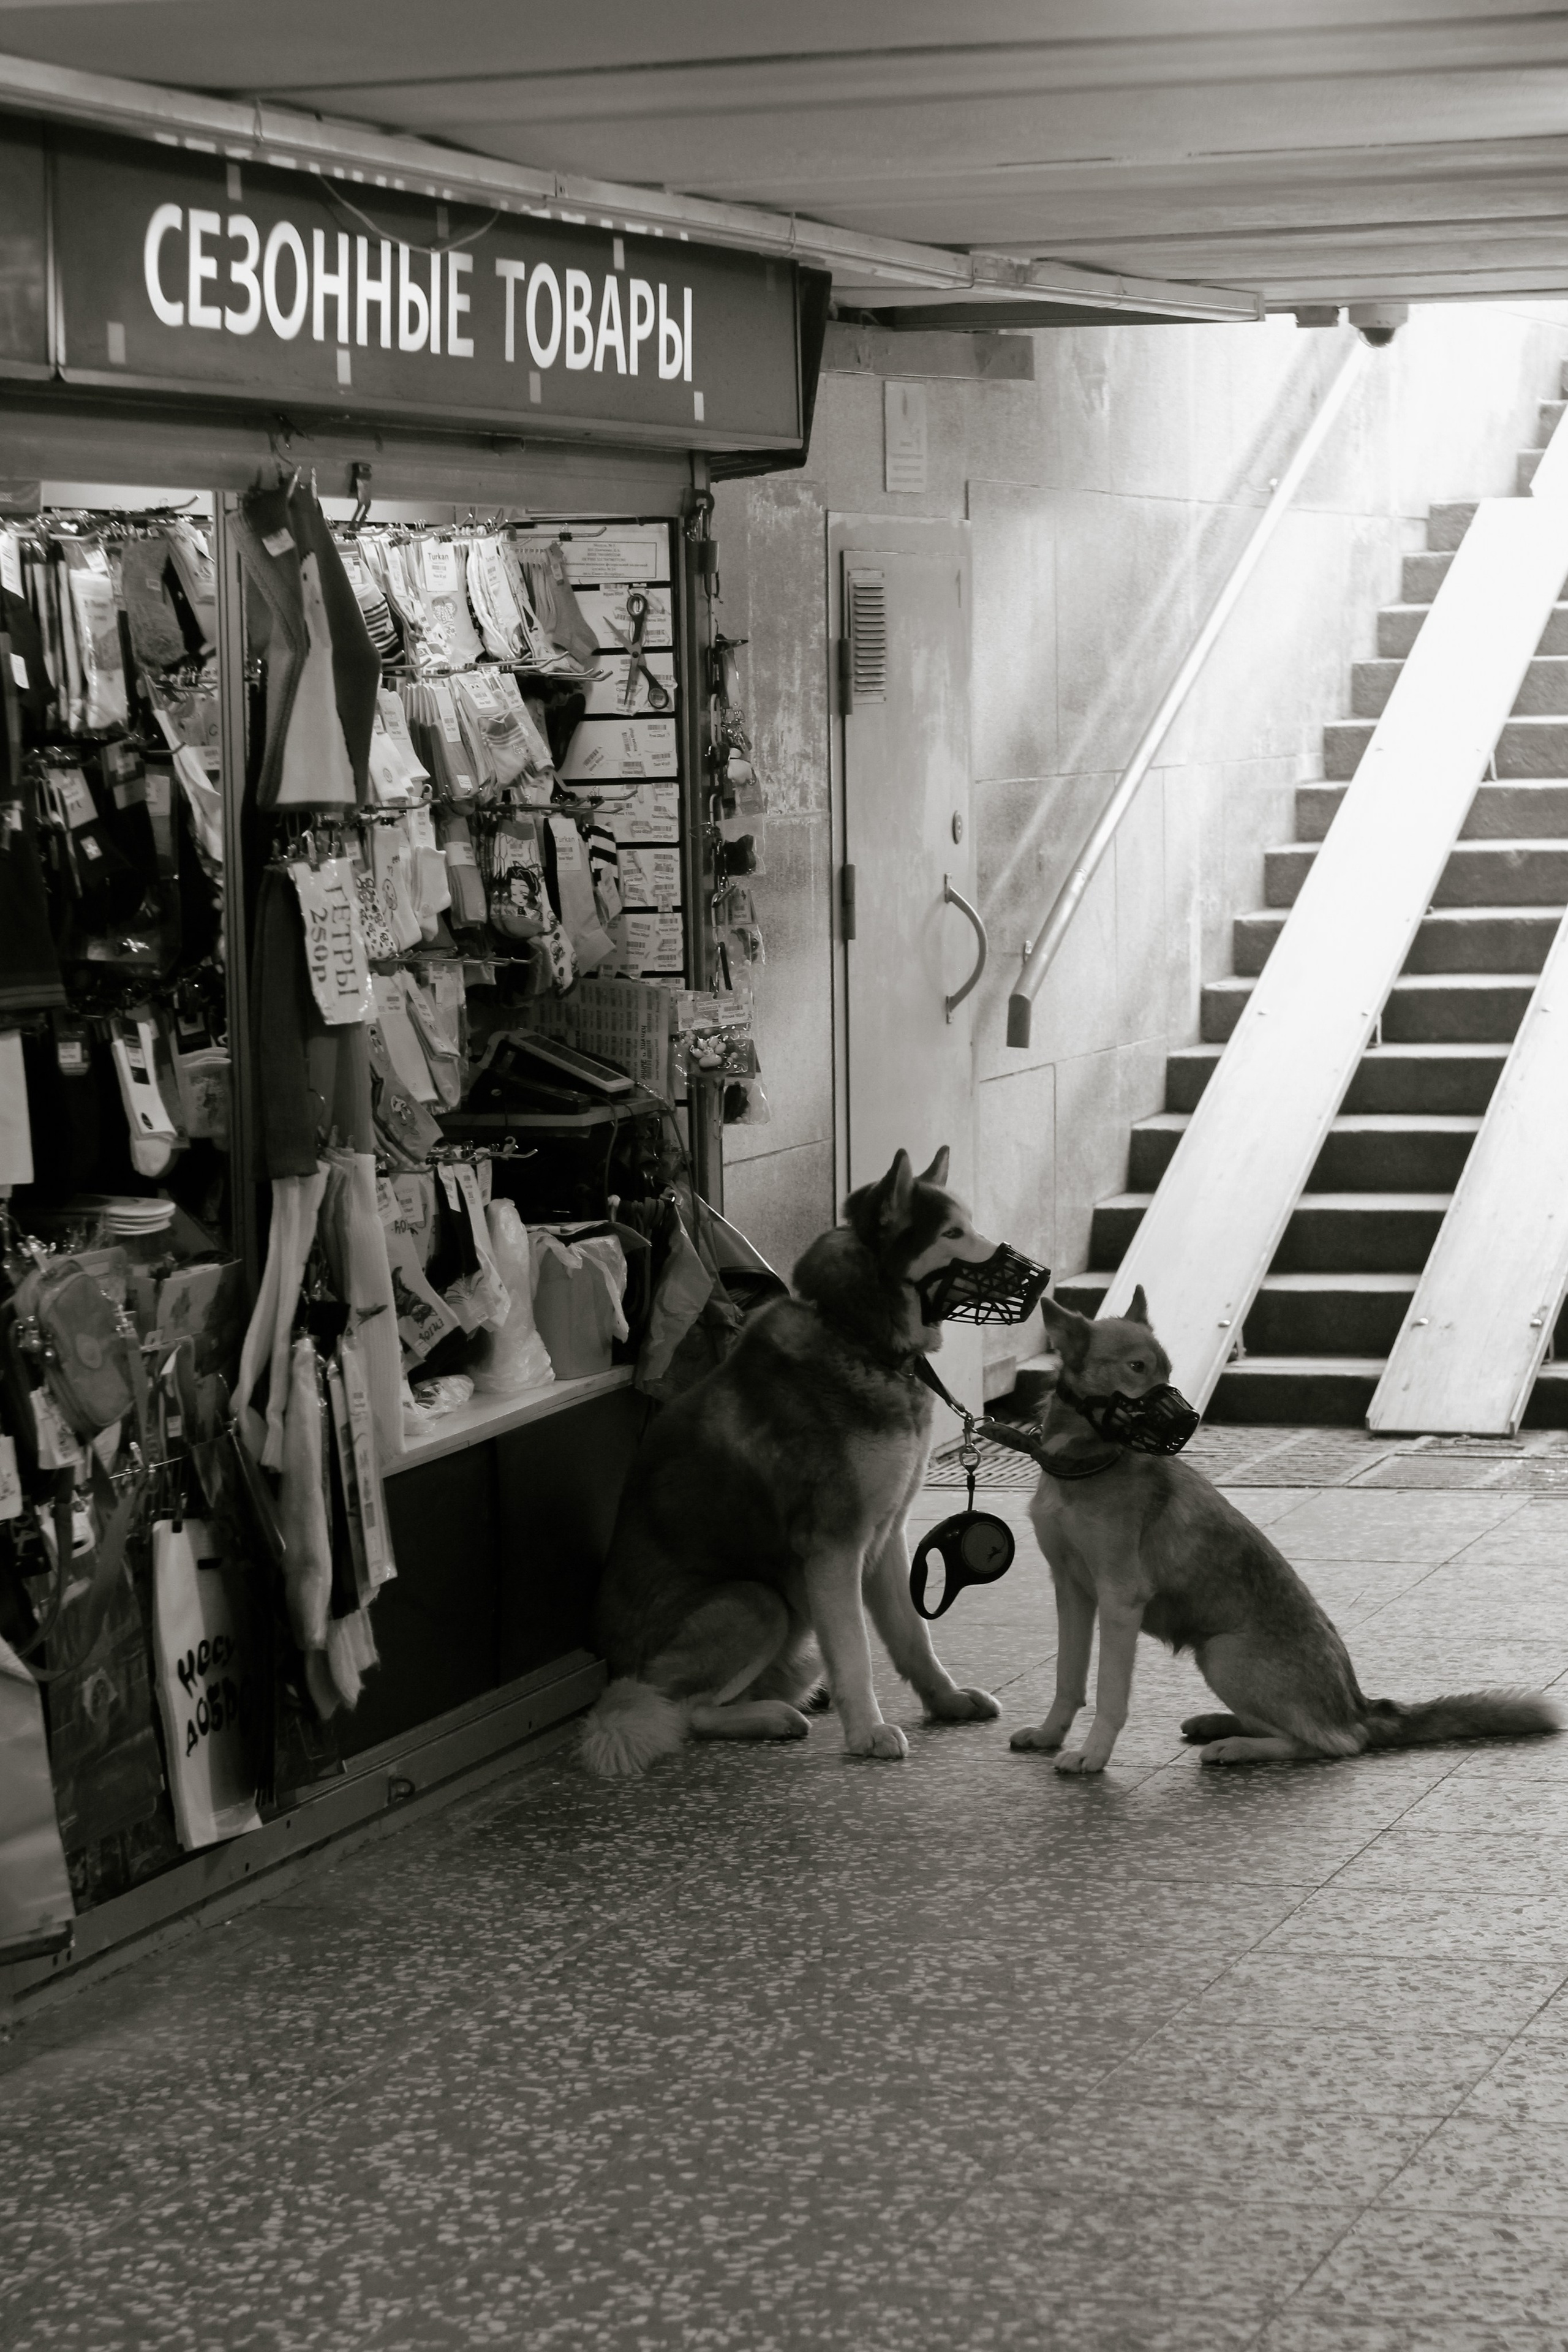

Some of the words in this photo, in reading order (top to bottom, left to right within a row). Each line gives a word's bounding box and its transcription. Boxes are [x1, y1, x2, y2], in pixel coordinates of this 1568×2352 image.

[144, 203, 474, 358] СЕЗОННЫЕ
[496, 257, 693, 382] ТОВАРЫ
[324, 886, 360, 996] ГЕТРЫ
